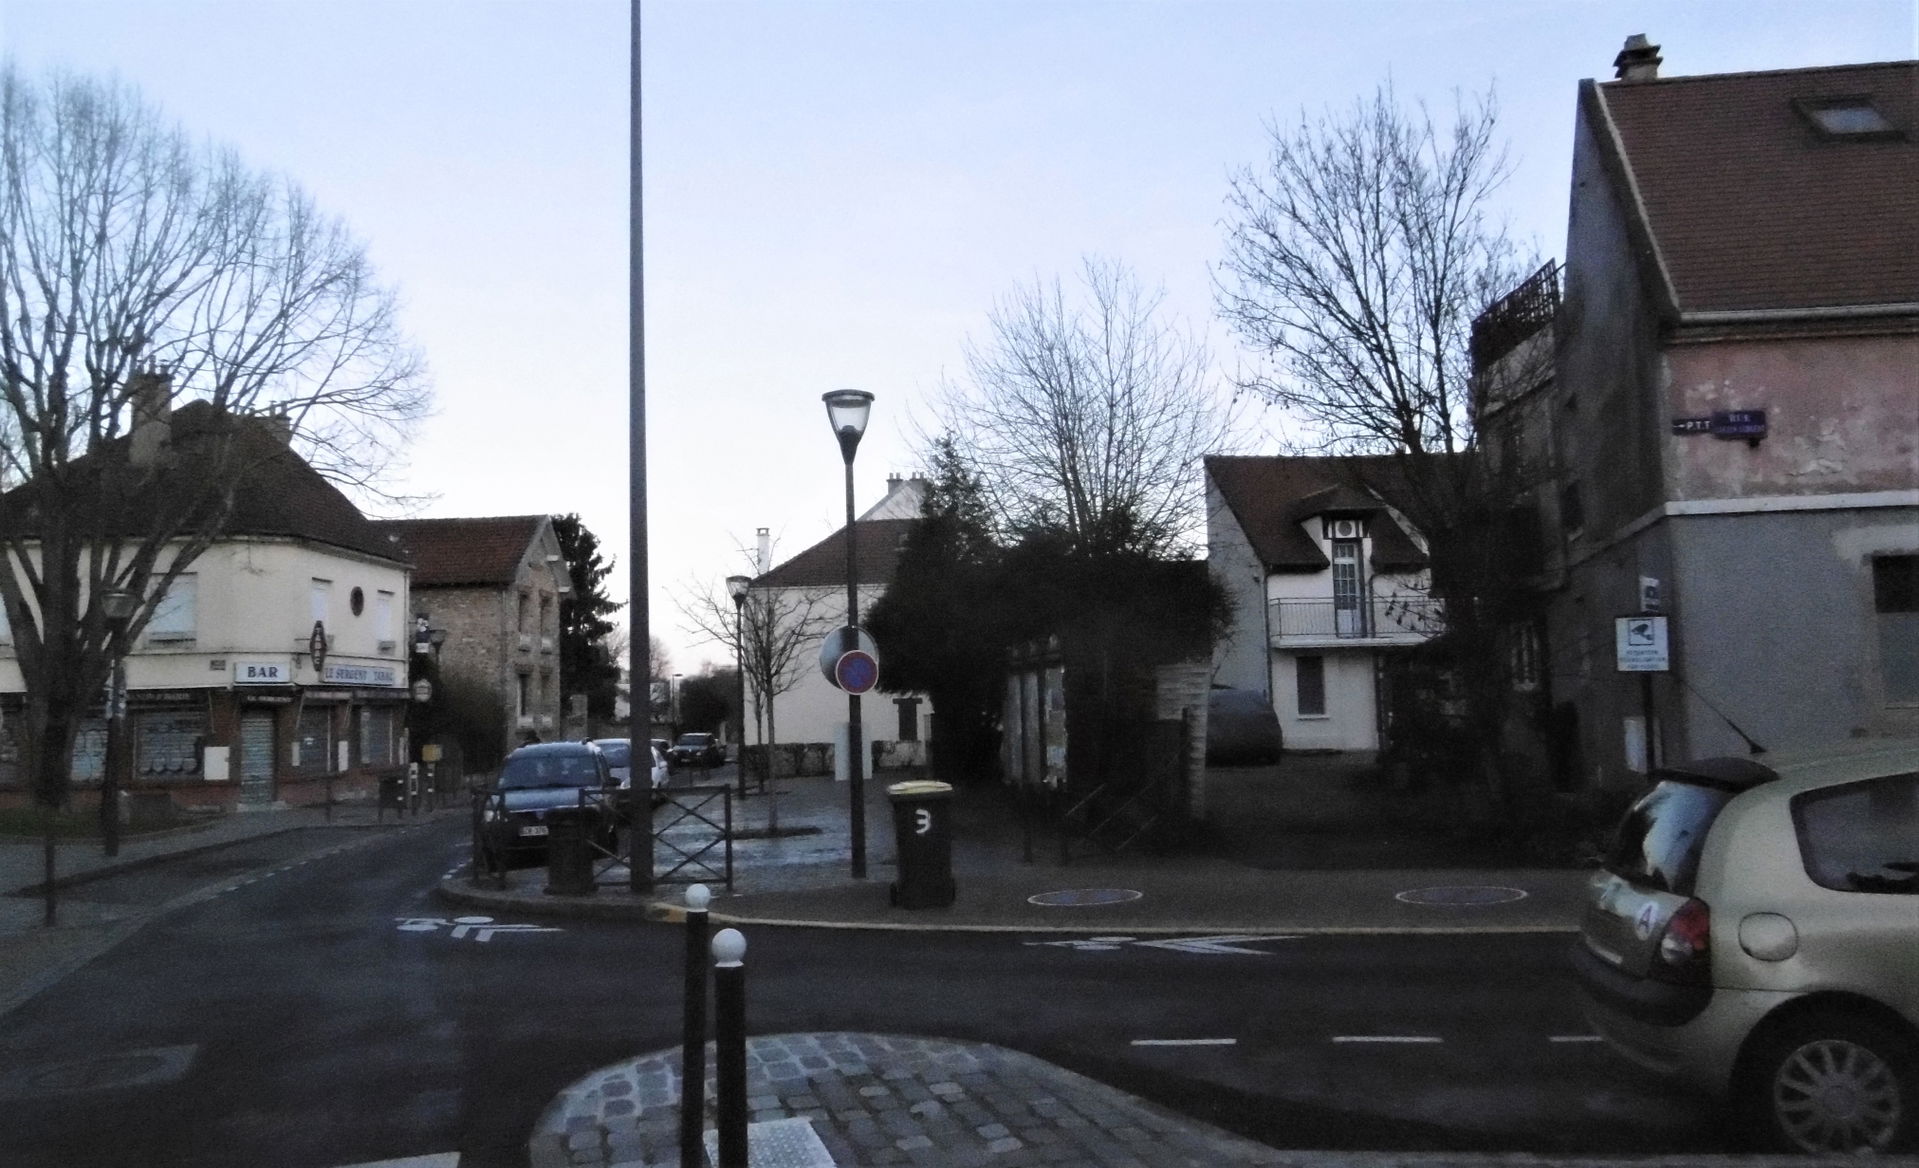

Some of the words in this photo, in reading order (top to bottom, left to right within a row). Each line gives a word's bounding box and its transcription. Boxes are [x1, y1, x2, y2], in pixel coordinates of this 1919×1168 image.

[247, 666, 279, 678] BAR
[325, 667, 334, 679] LE
[915, 808, 931, 834] 3
[1638, 904, 1653, 934] A
